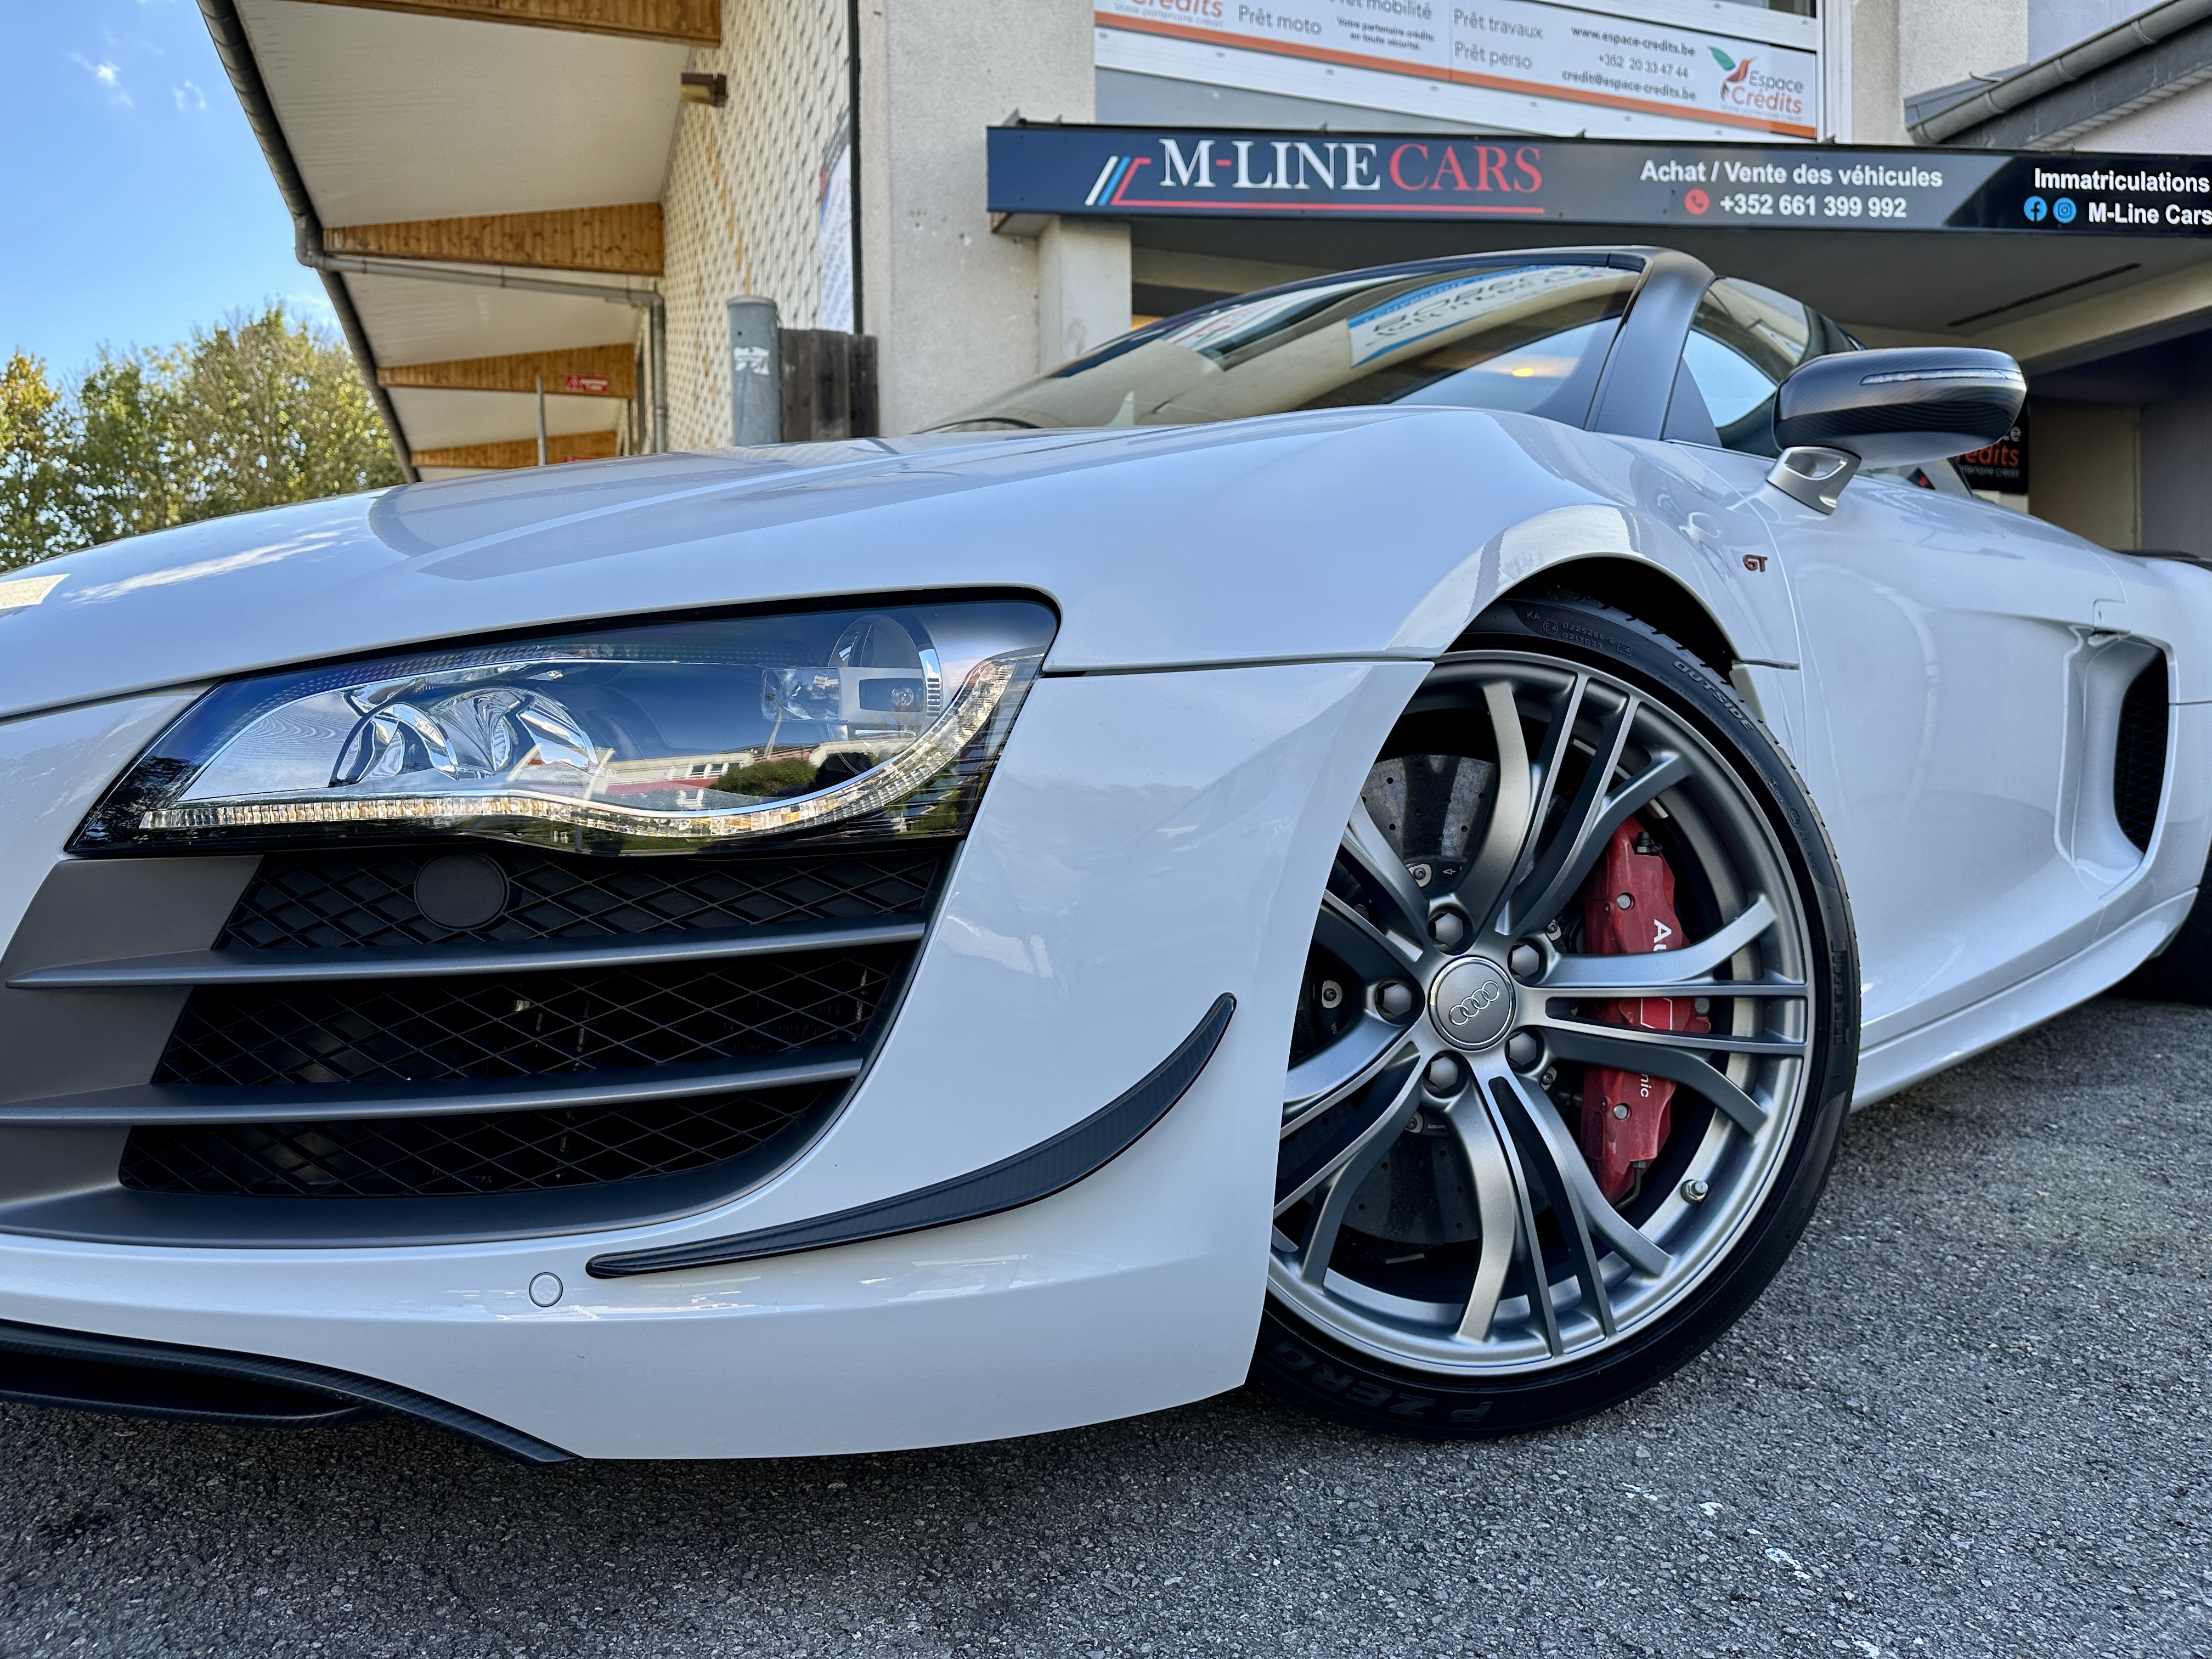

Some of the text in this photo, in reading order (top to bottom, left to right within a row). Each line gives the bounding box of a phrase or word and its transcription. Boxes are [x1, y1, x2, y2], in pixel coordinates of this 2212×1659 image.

[1238, 4, 1322, 35] Prêt moto
[1454, 8, 1543, 40] Prêt travaux
[1455, 40, 1533, 69] Prêt perso
[1629, 57, 1643, 71] 20
[1749, 70, 1804, 94] Espace
[1731, 86, 1803, 115] Crédits
[1159, 138, 1542, 193] M-LINE CARS
[1640, 159, 1943, 187] Achat / Vente des véhicules
[2034, 167, 2210, 193] Immatriculations
[1719, 193, 1907, 218] +352 661 399 992
[2089, 202, 2212, 225] M-Line Cars
[1742, 554, 1768, 572] GT
[1527, 611, 1540, 620] KA
[1673, 661, 1753, 731] OUTSIDE
[1267, 1341, 1436, 1417] ZERO
